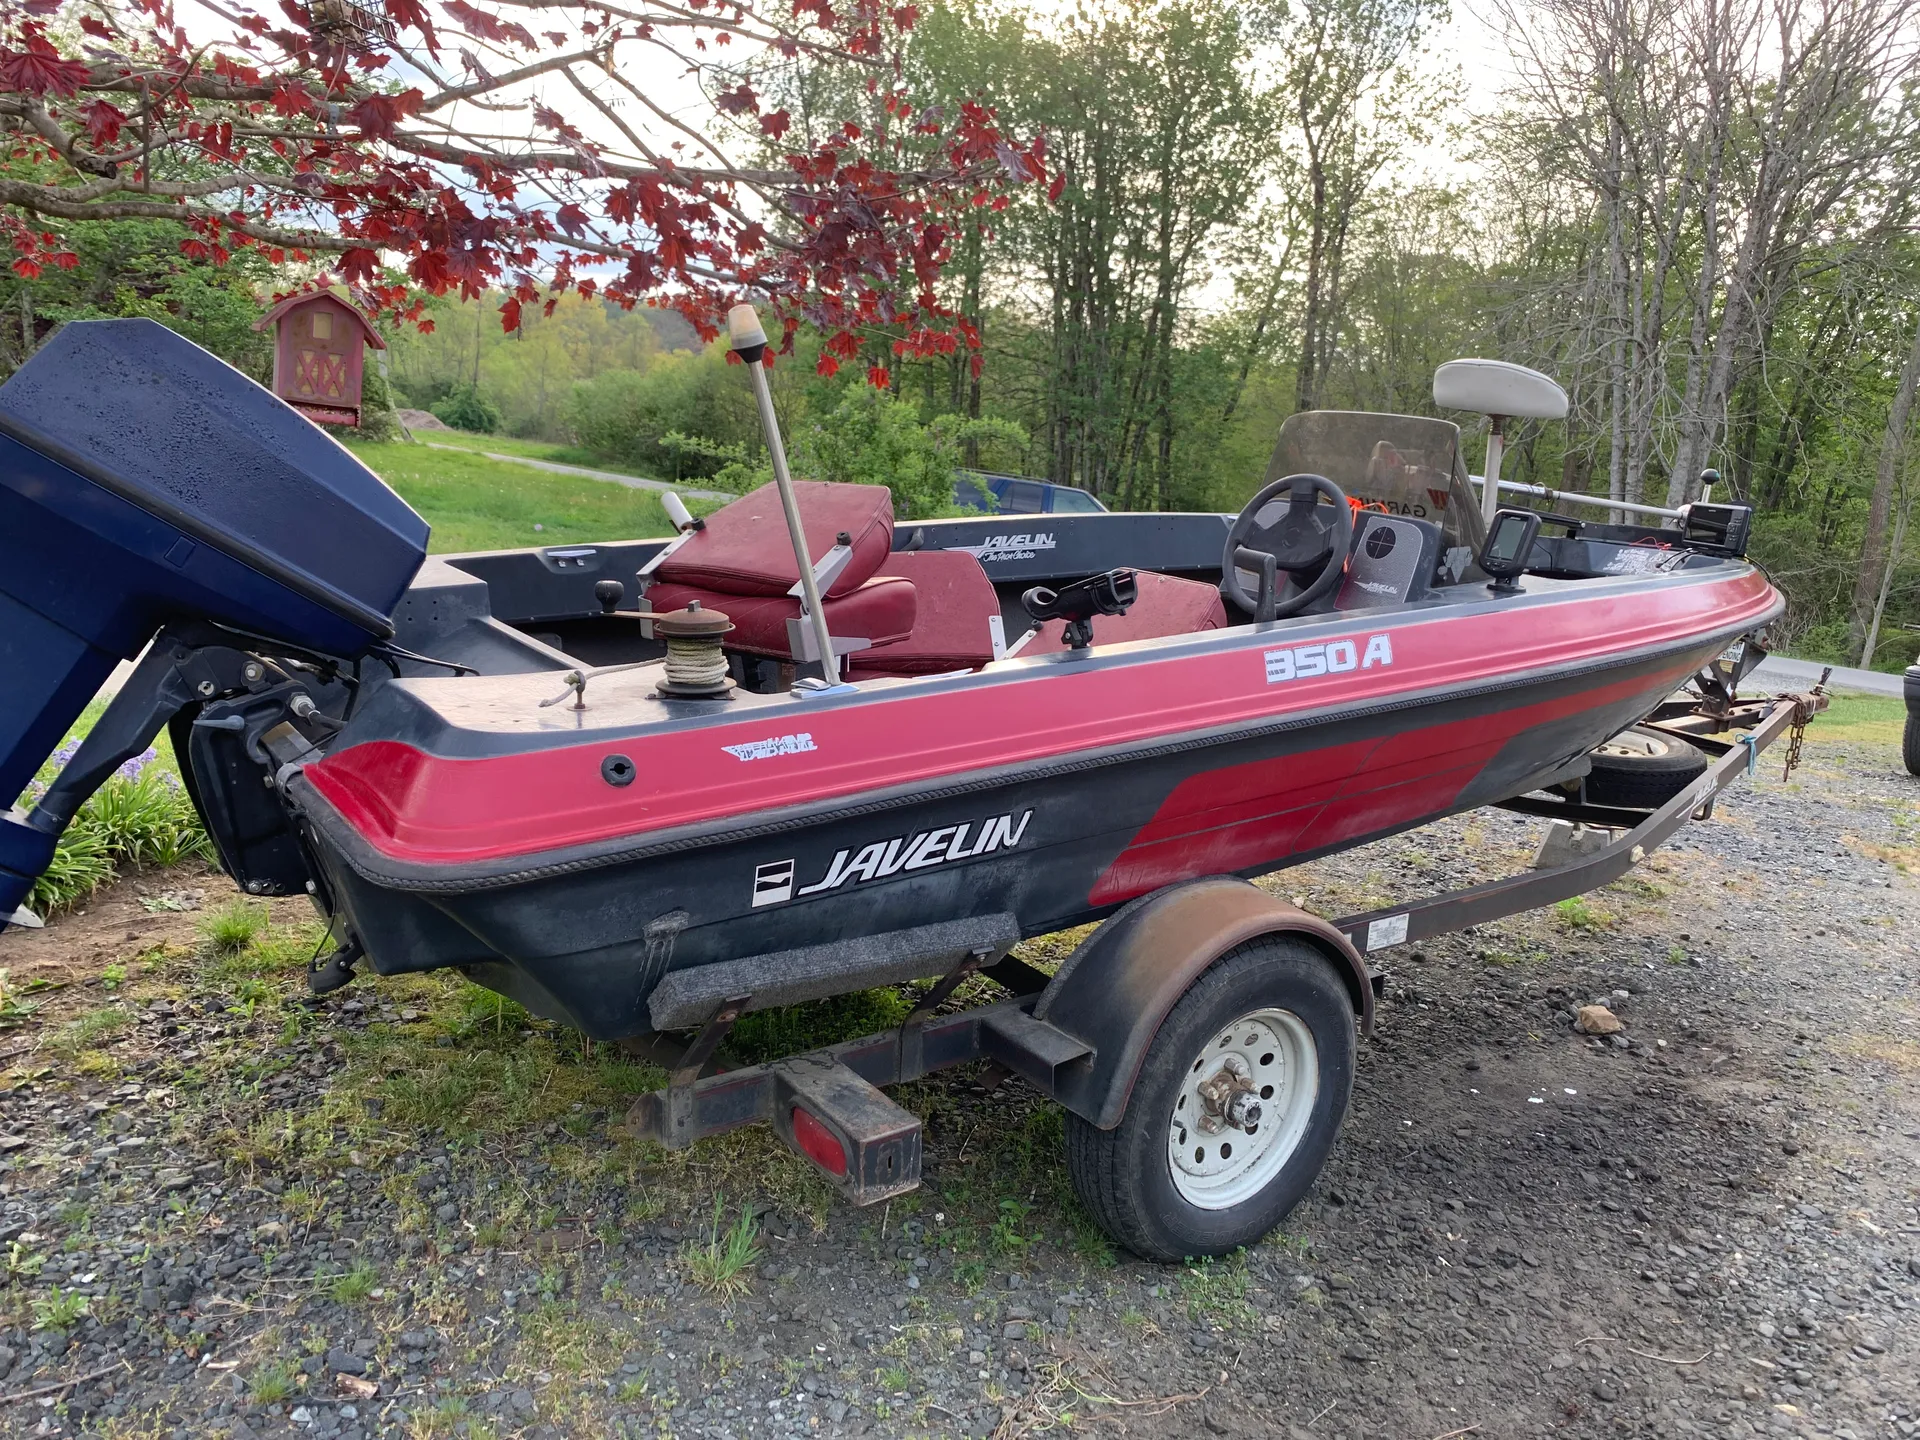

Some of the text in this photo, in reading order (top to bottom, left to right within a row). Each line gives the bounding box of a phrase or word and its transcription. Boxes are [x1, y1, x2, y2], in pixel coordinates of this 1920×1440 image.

[981, 533, 1056, 548] JAVELIN
[1264, 633, 1393, 685] 350 A
[796, 809, 1035, 897] JAVELIN
